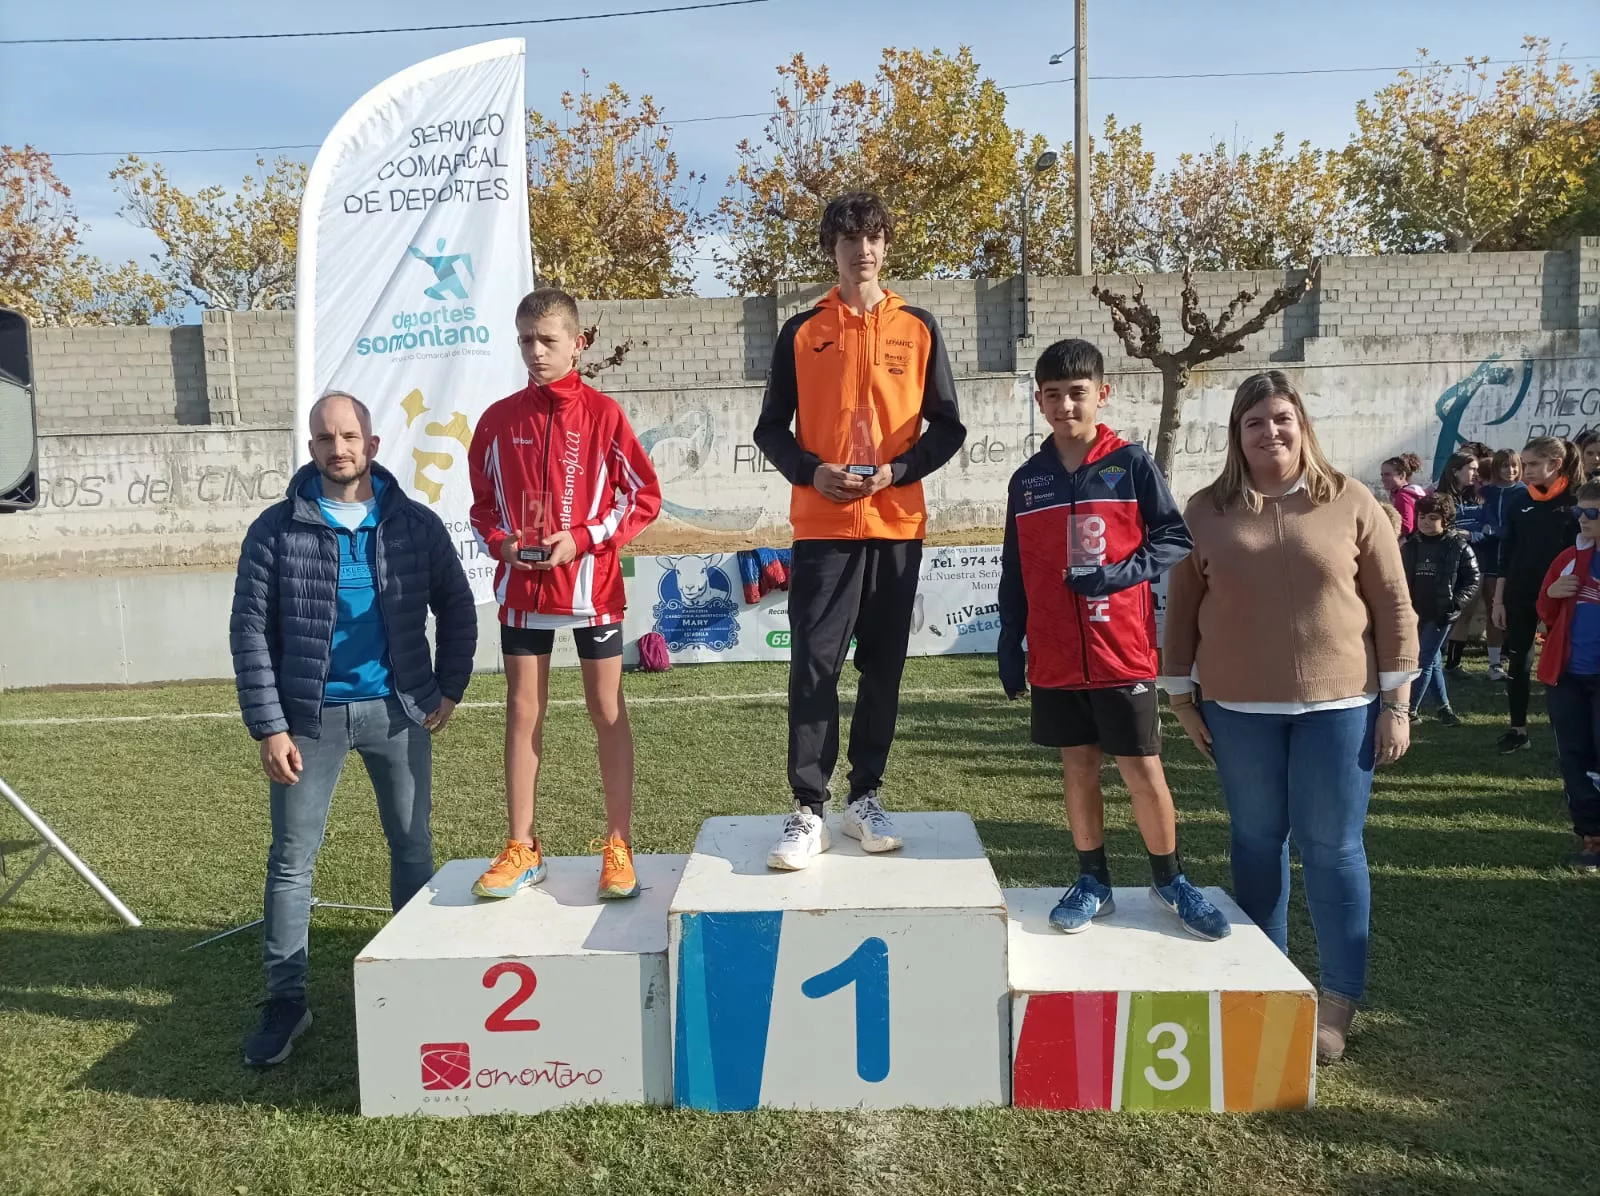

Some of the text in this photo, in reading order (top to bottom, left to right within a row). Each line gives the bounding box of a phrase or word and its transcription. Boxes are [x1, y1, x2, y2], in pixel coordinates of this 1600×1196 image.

[378, 146, 508, 180] COMARCAL
[344, 178, 509, 213] DE DEPORTES
[357, 325, 490, 355] somontano
[1534, 388, 1600, 417] RIEG
[970, 435, 1005, 463] de
[127, 475, 173, 504] del
[197, 469, 285, 501] CINC
[931, 557, 956, 568] Tel.
[961, 556, 986, 566] 974
[936, 571, 976, 580] Nuestra
[482, 962, 541, 1032] 2
[801, 936, 890, 1083] 1
[1143, 1021, 1192, 1091] 3
